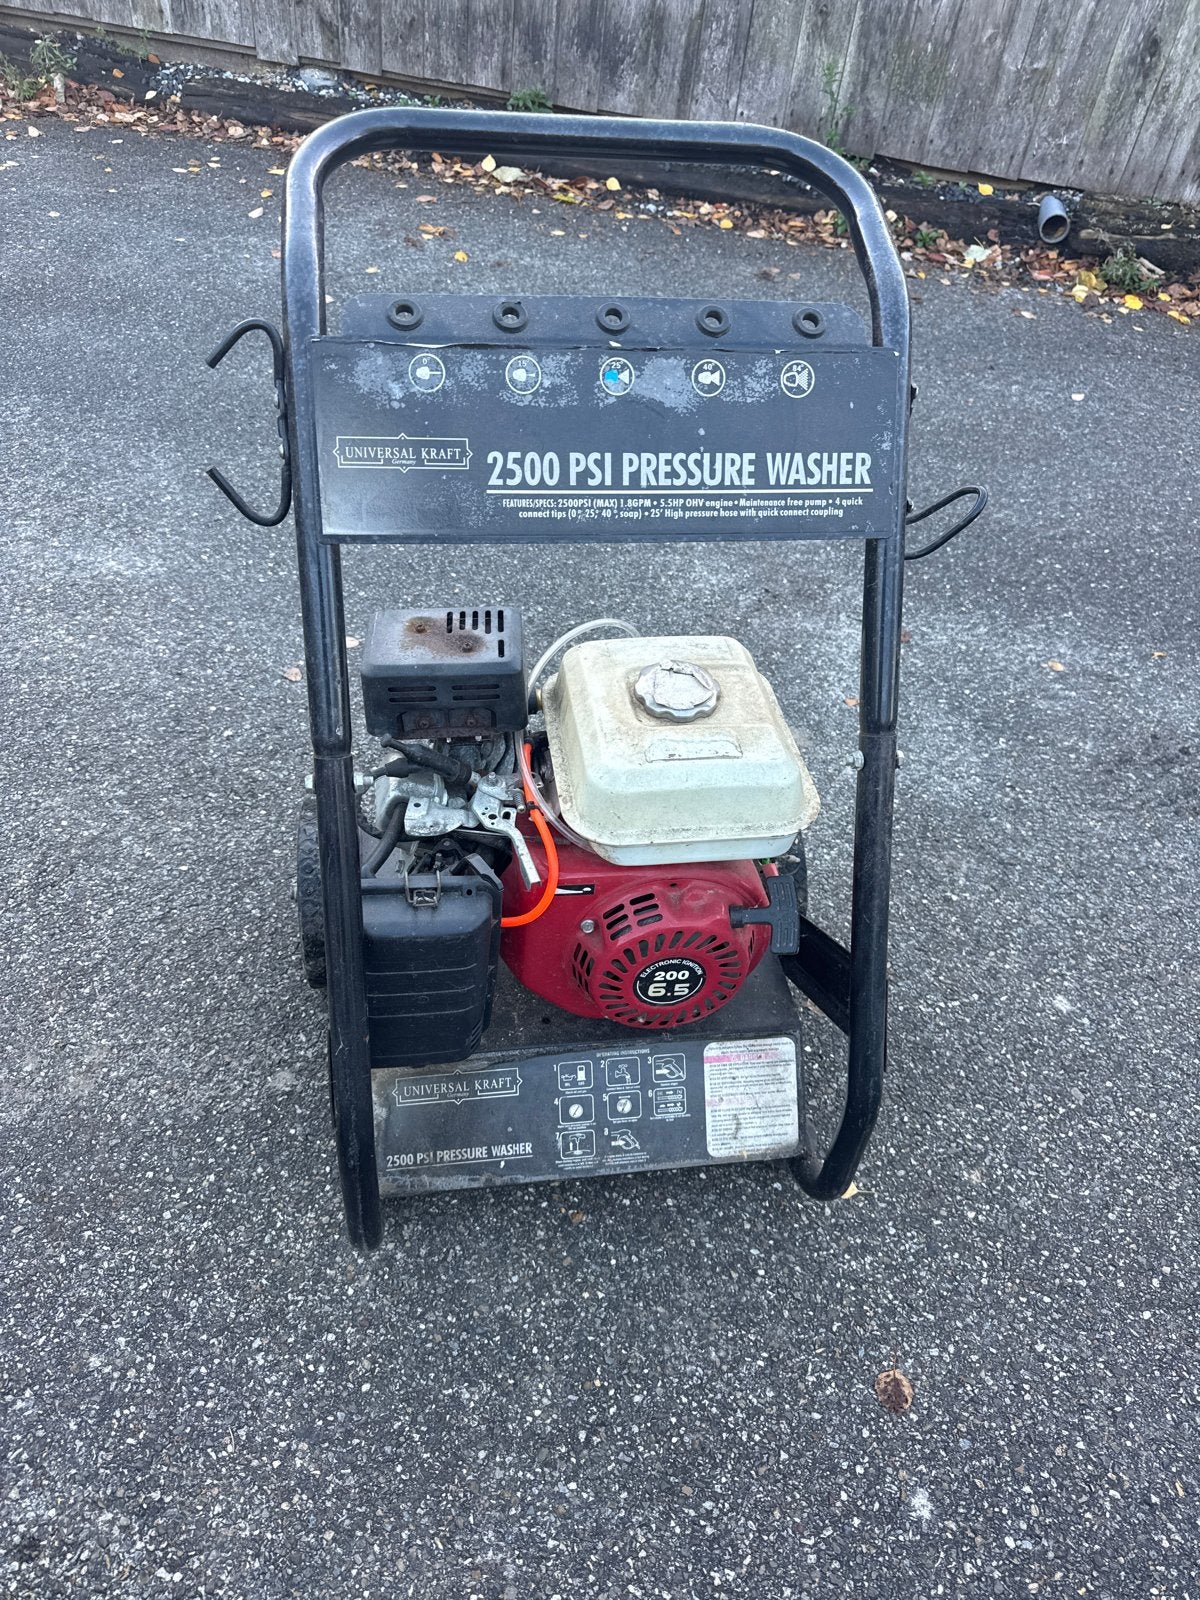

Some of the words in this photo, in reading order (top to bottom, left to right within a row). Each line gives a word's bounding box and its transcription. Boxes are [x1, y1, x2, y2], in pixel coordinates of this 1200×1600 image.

[345, 446, 416, 459] UNIVERSAL
[421, 447, 462, 460] KRAFT
[487, 451, 560, 486] 2500
[569, 451, 612, 486] PSI
[622, 451, 756, 487] PRESSURE
[766, 452, 872, 486] WASHER
[502, 498, 557, 508] FEATURES/SPECS:
[557, 498, 591, 508] 2500PSI
[593, 498, 618, 509] (MAX)
[620, 498, 651, 508] 1.8GPM
[660, 498, 684, 508] 5.5HP
[685, 498, 704, 508] OHV
[705, 498, 734, 510] engine
[739, 498, 786, 508] Maintenance
[787, 497, 803, 507] free
[804, 498, 827, 509] pump
[835, 497, 841, 507] 4
[841, 496, 863, 508] quick
[518, 509, 552, 519] connect
[552, 508, 567, 519] tips
[619, 508, 643, 520] soap)
[664, 508, 684, 519] High
[685, 509, 719, 519] pressure
[719, 508, 738, 517] hose
[740, 508, 757, 517] with
[757, 507, 779, 518] quick
[780, 507, 809, 517] connect
[810, 506, 843, 518] coupling
[640, 959, 682, 978] ELECTRONIC
[682, 959, 703, 976] IGNITION
[653, 970, 690, 981] 200
[647, 982, 690, 997] 6.5
[403, 1082, 470, 1097] UNIVERSAL
[475, 1077, 512, 1091] KRAFT
[386, 1153, 414, 1168] 2500
[416, 1152, 434, 1164] PSI
[436, 1146, 488, 1162] PRESSURE
[491, 1142, 533, 1157] WASHER
